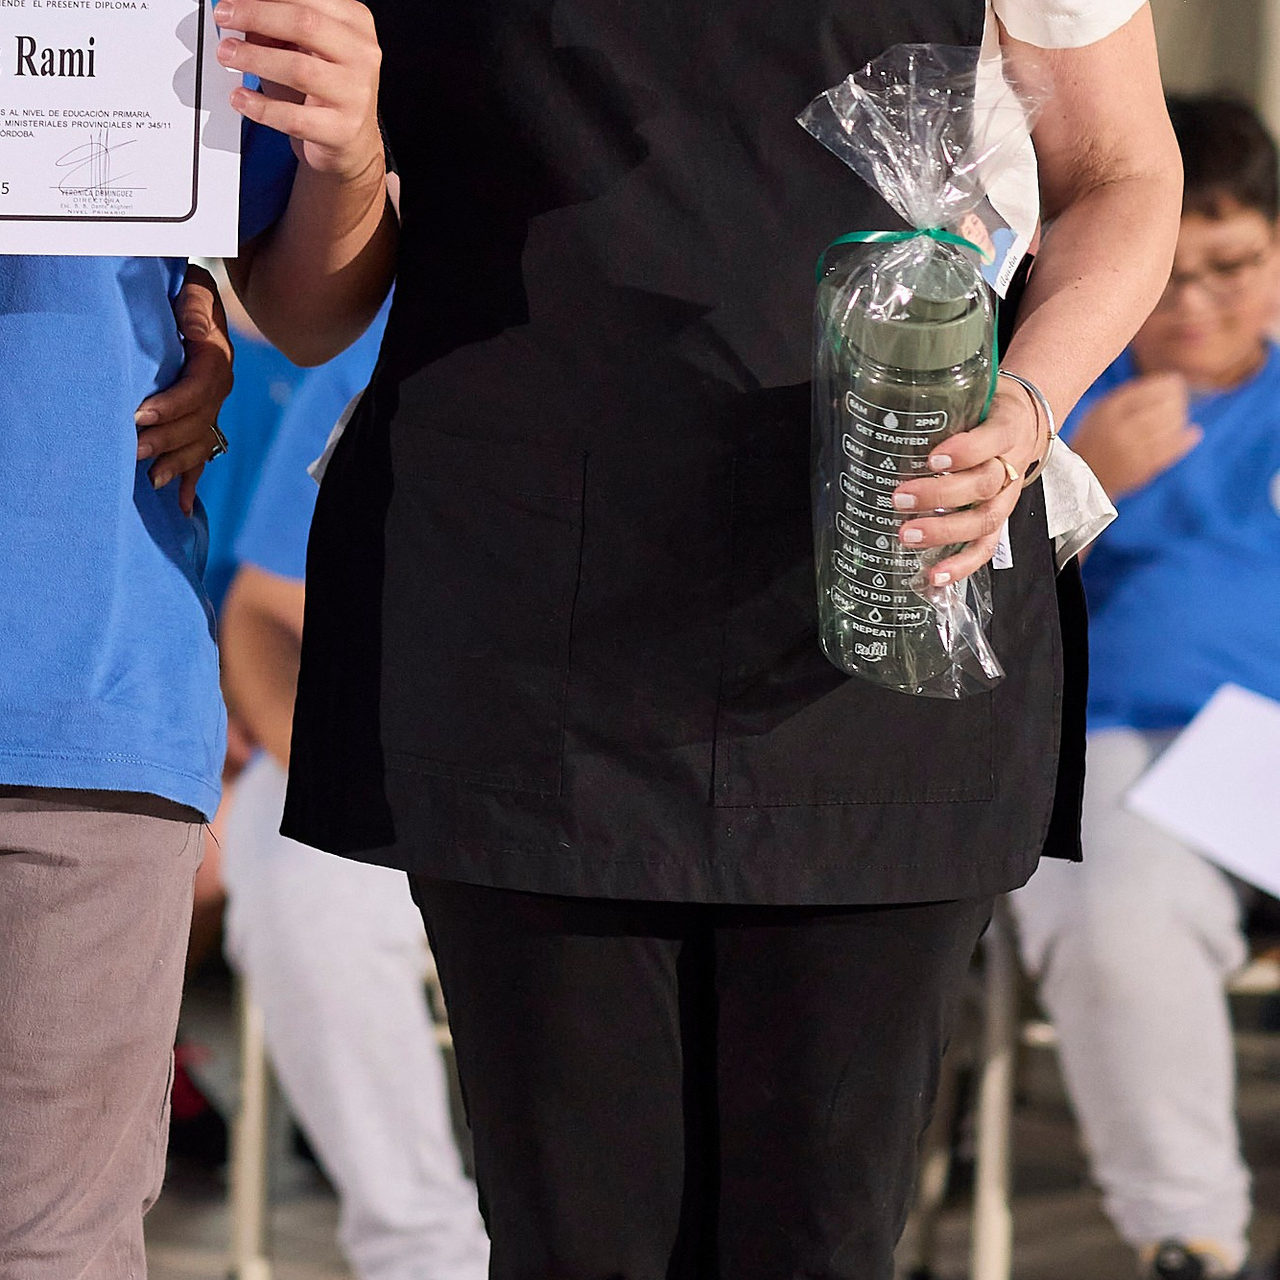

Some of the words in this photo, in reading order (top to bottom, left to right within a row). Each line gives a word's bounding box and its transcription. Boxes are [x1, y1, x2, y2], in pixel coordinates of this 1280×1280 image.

[33, 0, 43, 8] EL
[46, 0, 91, 10] PRESENTE
[95, 0, 137, 10] DIPLOMA
[140, 2, 150, 11] A:
[14, 35, 96, 78] Rami
[9, 109, 19, 117] AL
[23, 109, 45, 118] NIVEL
[49, 109, 60, 119] DE
[63, 109, 110, 119] EDUCACIÓN
[5, 120, 68, 129] MINISTERIALES
[72, 121, 132, 130] PROVINCIALES
[915, 417, 940, 427] 2PM
[855, 423, 874, 437] GET
[875, 432, 929, 446] STARTED!
[850, 464, 874, 481] KEEP
[910, 461, 929, 469] 3P
[845, 502, 875, 522] DON'T
[843, 543, 881, 564] ALMOST
[847, 583, 869, 598] YOU
[870, 593, 891, 603] DID
[897, 612, 921, 621] 7PM
[852, 622, 896, 639] REPEAT!
